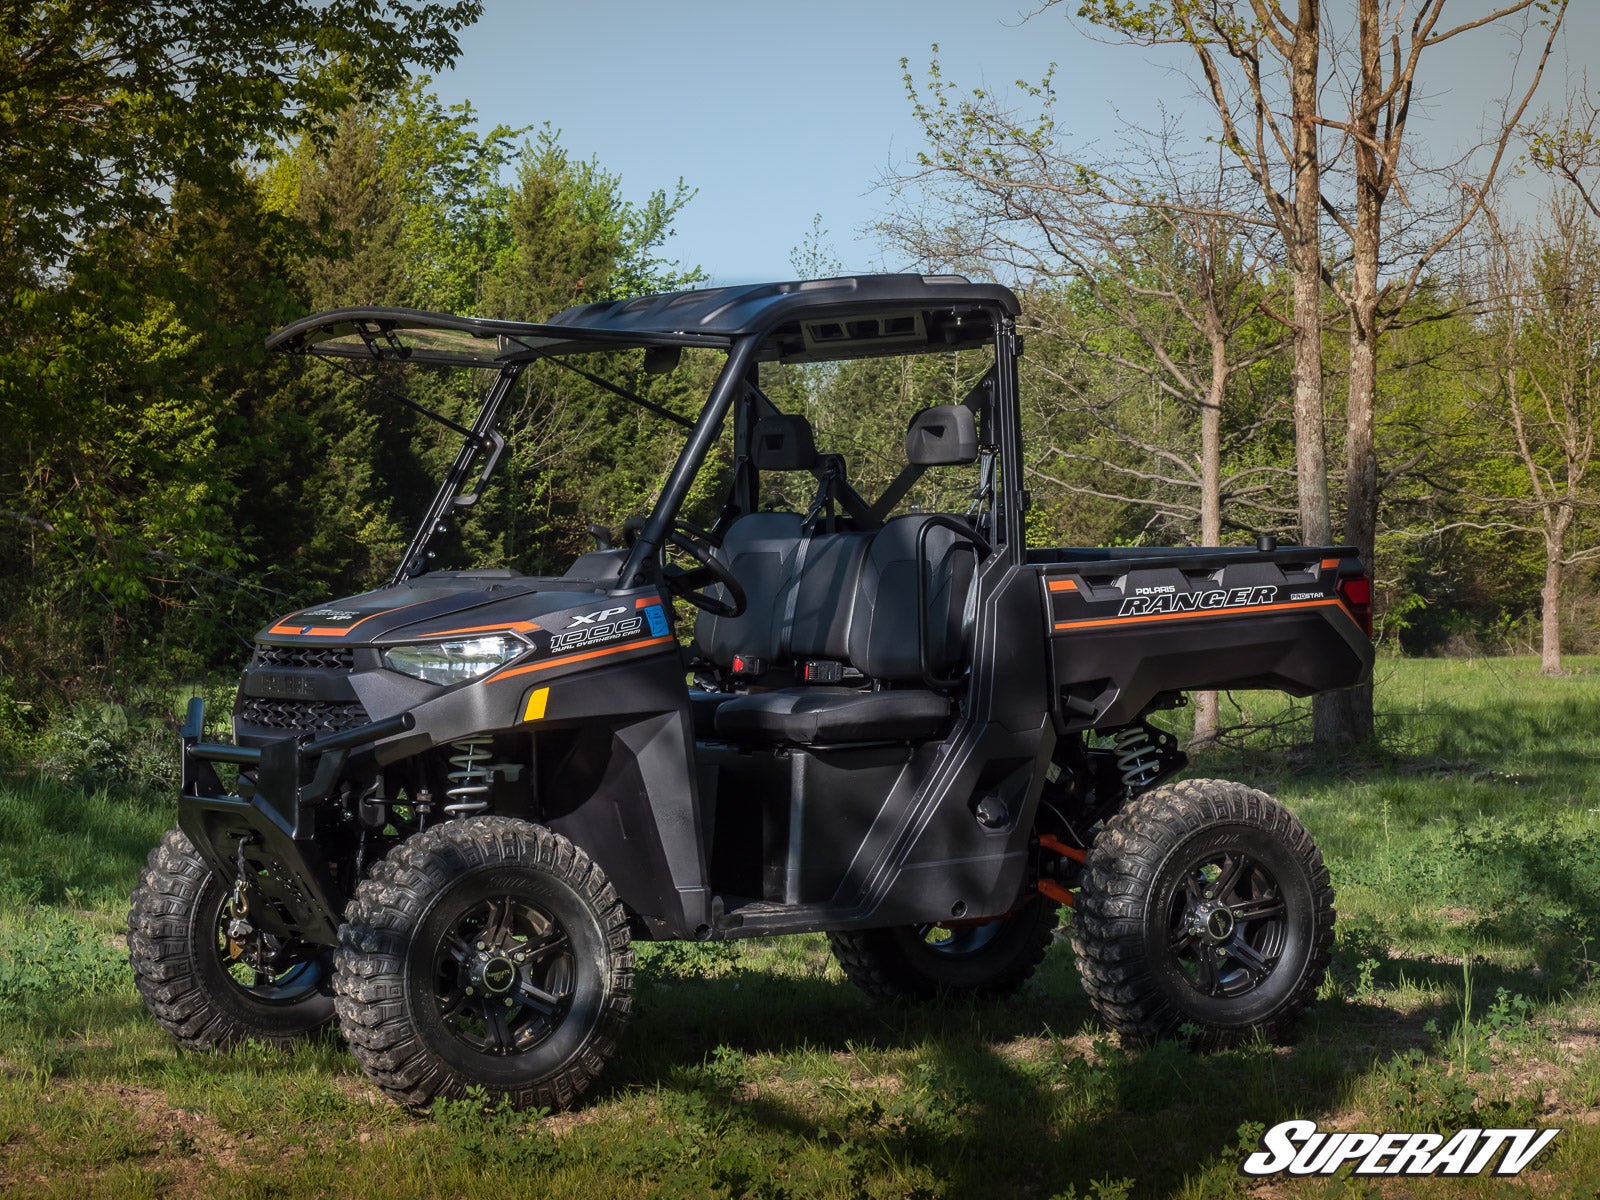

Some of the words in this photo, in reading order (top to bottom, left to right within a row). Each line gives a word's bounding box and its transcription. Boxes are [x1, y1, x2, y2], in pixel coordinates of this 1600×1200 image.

[1118, 584, 1278, 617] RANGER
[1135, 585, 1176, 596] POLARIS
[1290, 591, 1324, 601] PROSTAR
[563, 606, 628, 629] XP
[550, 616, 643, 649] 1000
[551, 643, 575, 653] DUAL
[576, 633, 621, 648] OVERHEAD
[622, 628, 641, 638] CAM
